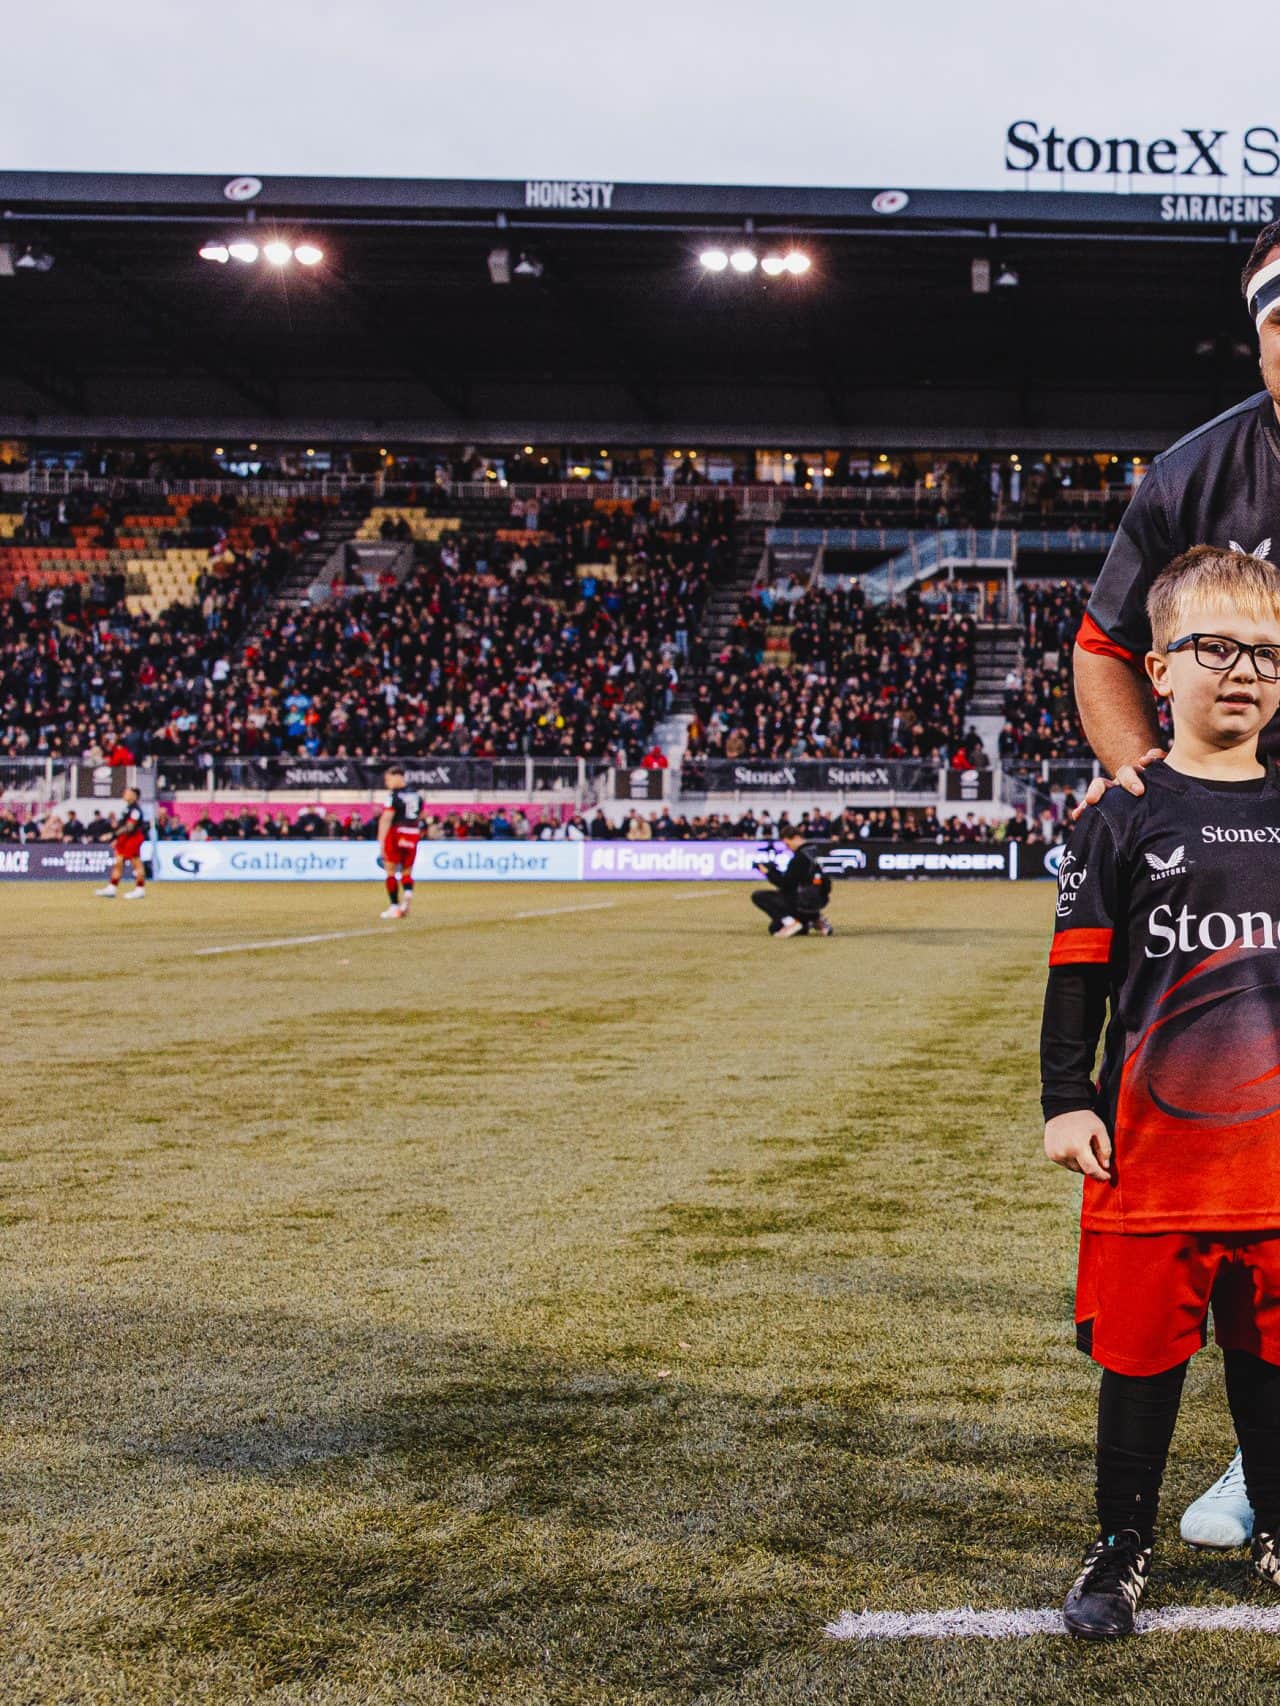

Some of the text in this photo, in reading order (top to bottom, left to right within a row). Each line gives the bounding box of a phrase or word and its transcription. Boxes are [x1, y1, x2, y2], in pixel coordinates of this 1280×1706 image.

[1005, 119, 1228, 177] StoneX
[525, 181, 614, 209] HONESTY
[1160, 195, 1274, 223] SARACENS
[286, 766, 348, 785] StoneX
[404, 767, 450, 784] oneX
[735, 767, 796, 785] StoneX
[828, 767, 889, 785] StoneX
[0, 851, 29, 872] RACE
[231, 851, 348, 873] Gallagher
[433, 851, 549, 873] Gallagher
[618, 848, 715, 876] Funding
[878, 854, 1005, 870] DEFENDER
